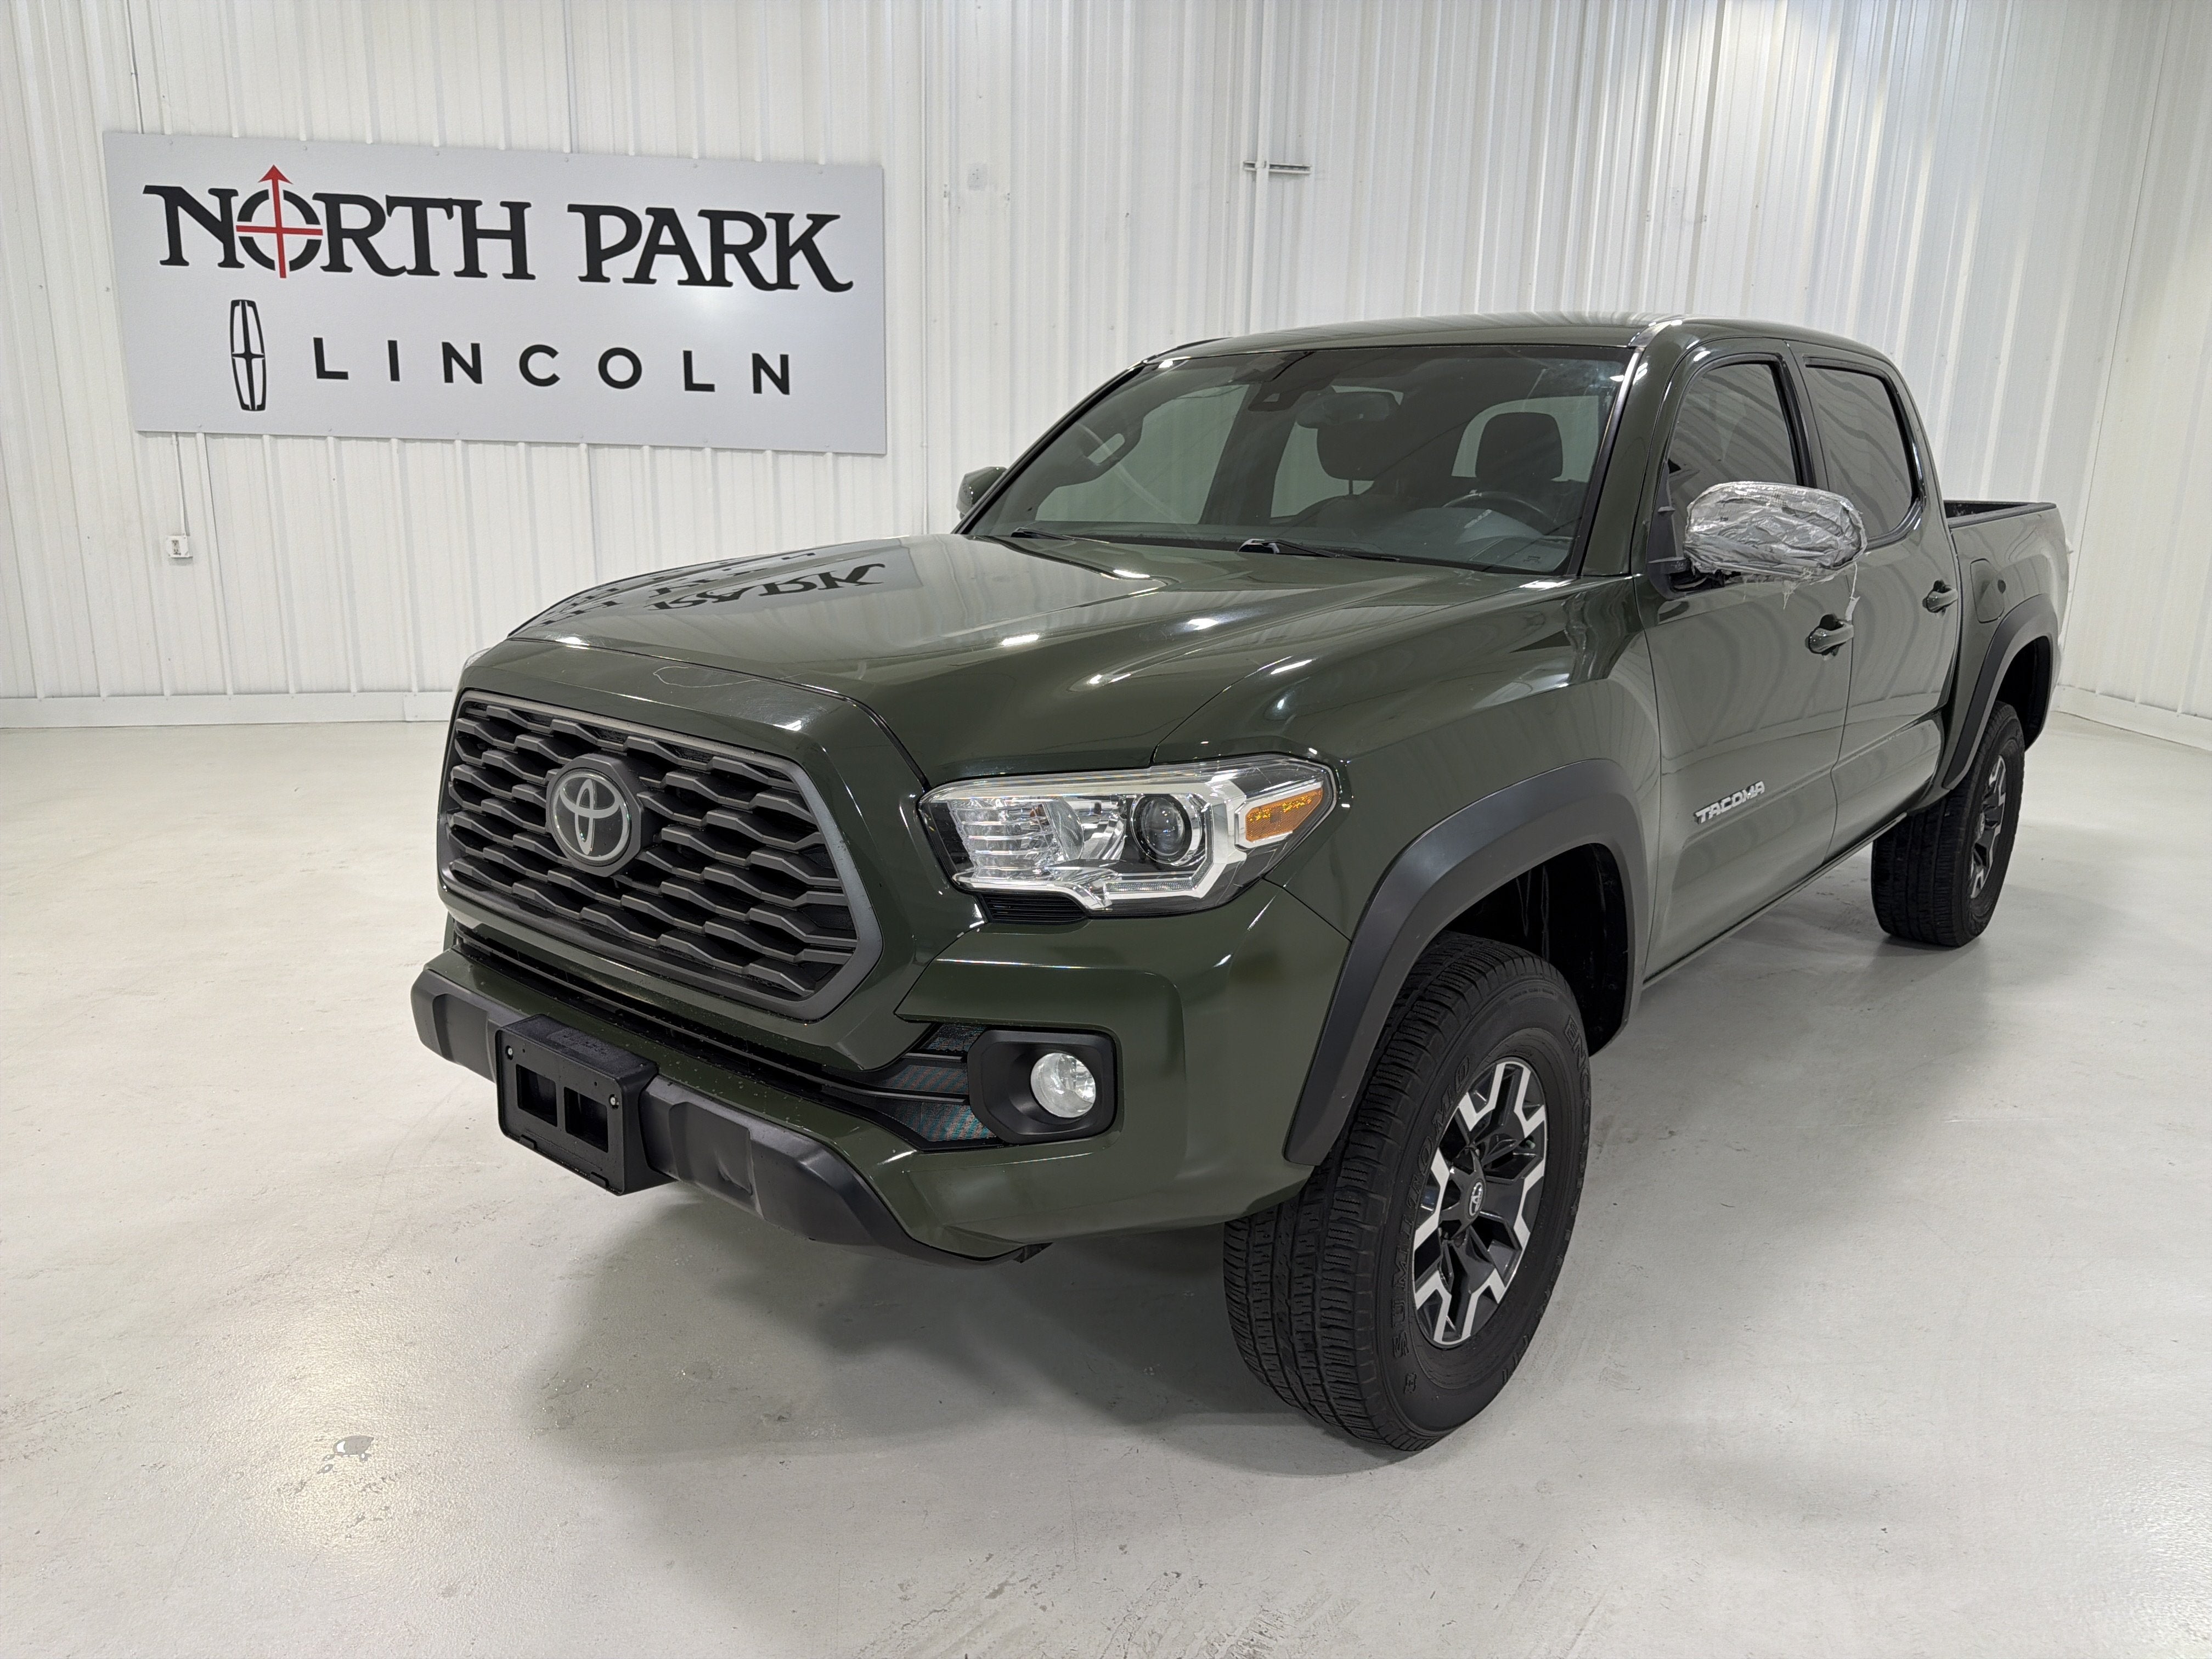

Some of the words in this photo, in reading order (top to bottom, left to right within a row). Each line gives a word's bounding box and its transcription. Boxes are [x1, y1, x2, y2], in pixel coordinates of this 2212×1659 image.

[143, 184, 537, 281] NORTH
[567, 203, 853, 292] PARK
[313, 337, 790, 396] LINCOLN
[1694, 780, 1765, 824] TACOMA
[1392, 1055, 1471, 1358] SUMITOMO
